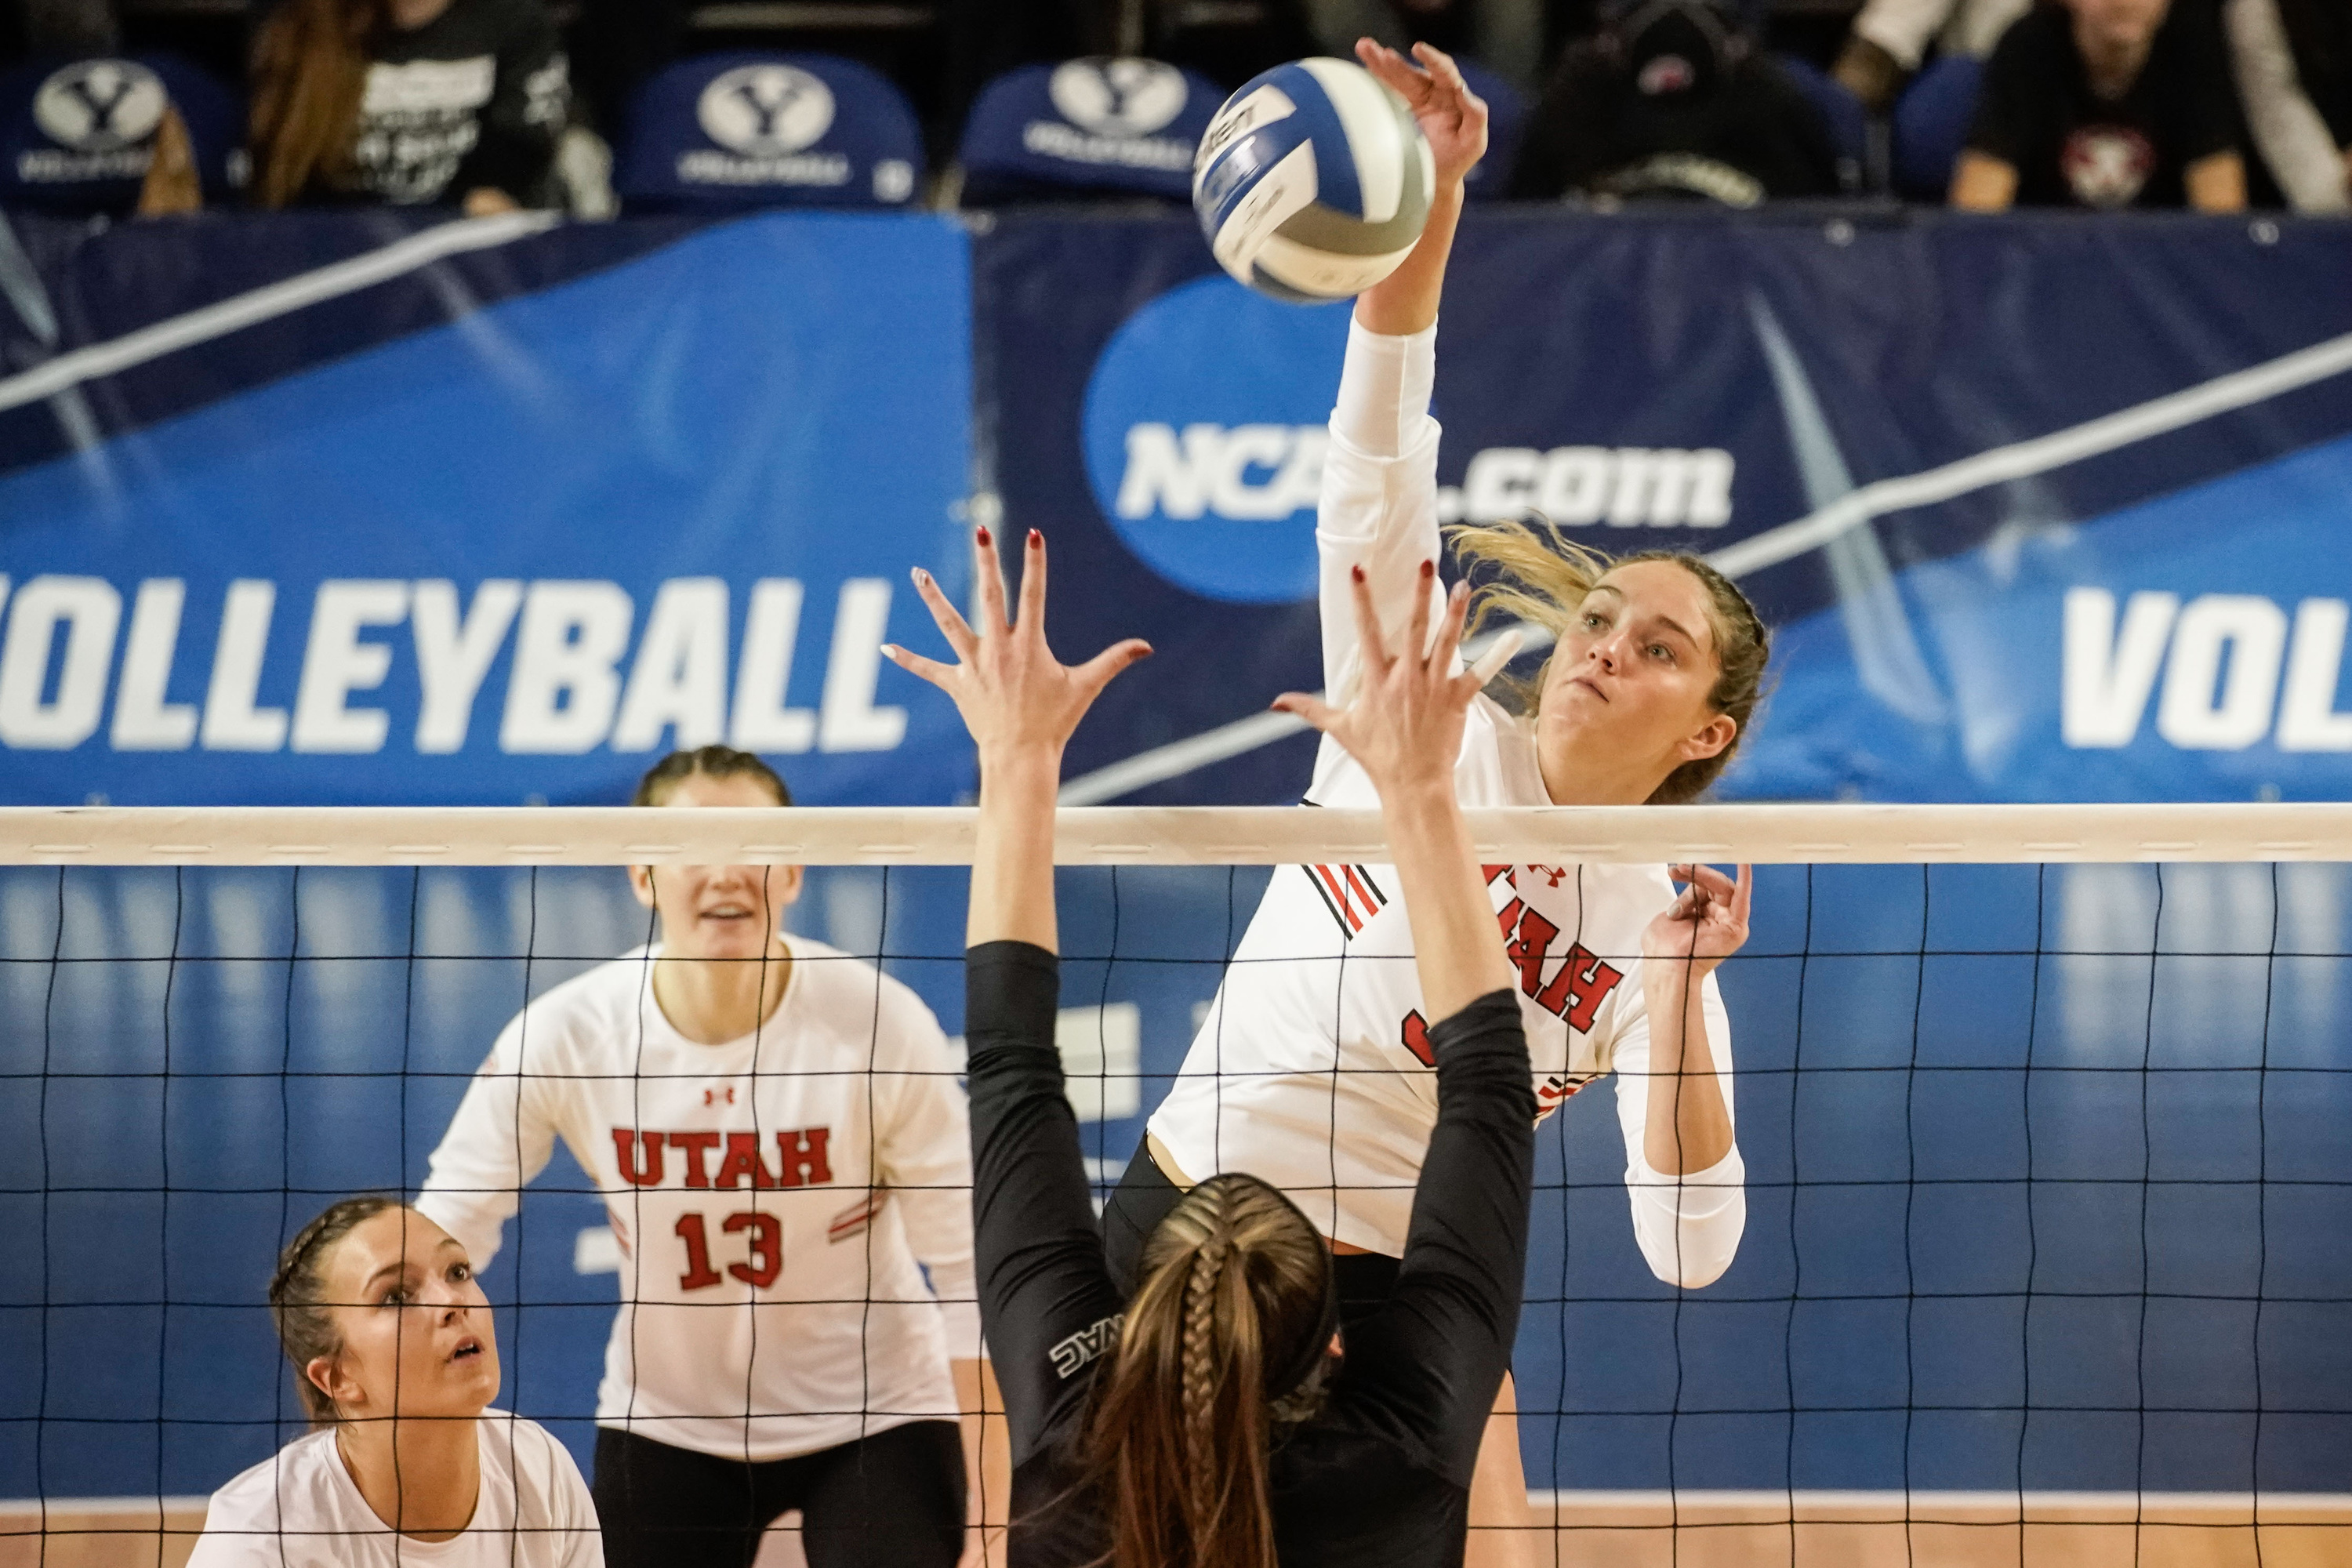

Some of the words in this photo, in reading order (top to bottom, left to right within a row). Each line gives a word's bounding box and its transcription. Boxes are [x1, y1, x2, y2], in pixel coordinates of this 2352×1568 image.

[0, 573, 906, 754] OLLEYBALL
[612, 1127, 833, 1189] UTAH
[675, 1212, 782, 1291] 13
